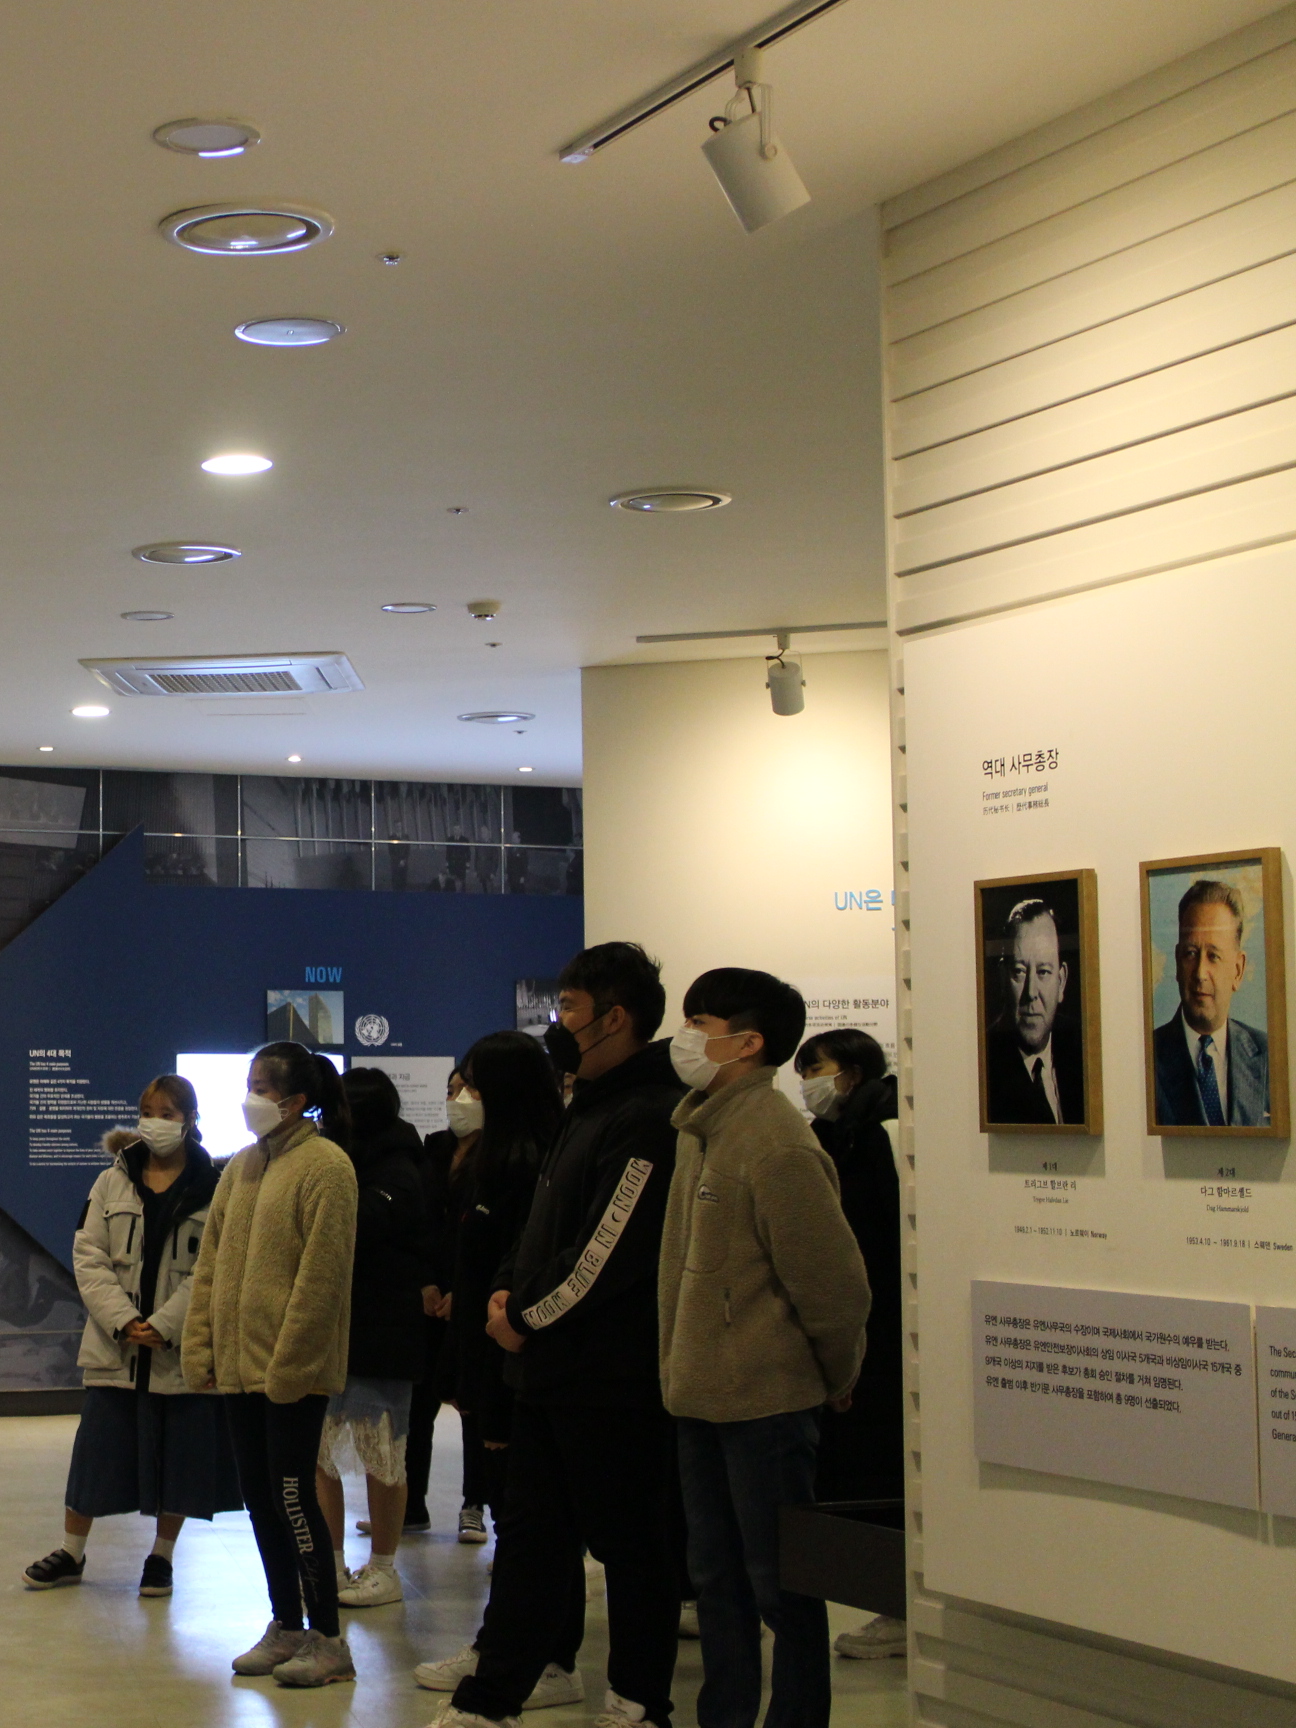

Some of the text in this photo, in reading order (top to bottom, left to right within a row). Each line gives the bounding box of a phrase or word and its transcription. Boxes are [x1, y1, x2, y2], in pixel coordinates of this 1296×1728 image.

[982, 747, 1059, 779] 역대 사무총장
[982, 781, 1049, 802] Former secretary general
[834, 889, 883, 911] UN은
[305, 966, 343, 983] NOW
[823, 999, 850, 1010] 다양한
[853, 998, 889, 1010] 활동분야
[29, 1049, 45, 1058] UN의
[1200, 1186, 1215, 1196] 다그
[524, 1157, 653, 1328] MOON IN BLUE MOON
[1186, 1236, 1211, 1246] 1953.4.10
[1254, 1241, 1271, 1250] 스웨덴
[1273, 1242, 1294, 1251] Sweden
[984, 1314, 998, 1326] 유엔
[999, 1316, 1031, 1330] 사무총장은
[1033, 1320, 1072, 1334] 유엔사무국의
[1074, 1324, 1100, 1336] 수장이며
[1102, 1327, 1143, 1342] 국제사회에서
[1206, 1338, 1230, 1351] 받는다.
[985, 1335, 998, 1346] 유엔
[1000, 1337, 1032, 1351] 사무총장은
[1100, 1348, 1115, 1360] 상임
[1116, 1350, 1137, 1363] 이사국
[1139, 1353, 1164, 1366] 5개국과
[1210, 1362, 1232, 1374] 15개국
[1234, 1364, 1242, 1376] 중
[1269, 1345, 1282, 1357] The
[985, 1356, 1002, 1367] 9개국
[1004, 1358, 1023, 1370] 이상의
[1046, 1363, 1060, 1375] 받은
[1083, 1367, 1097, 1379] 총회
[1153, 1376, 1184, 1391] 임명된다.
[986, 1375, 999, 1388] 유엔
[1015, 1379, 1028, 1391] 이후
[1030, 1381, 1050, 1394] 반기문
[1051, 1384, 1085, 1400] 사무총장을
[1086, 1389, 1114, 1404] 포함하여
[1115, 1393, 1122, 1404] 총
[1270, 1388, 1277, 1398] of
[1278, 1388, 1289, 1399] the
[1271, 1410, 1282, 1419] out
[1283, 1410, 1290, 1420] of
[282, 1476, 314, 1555] HOLLISTER
